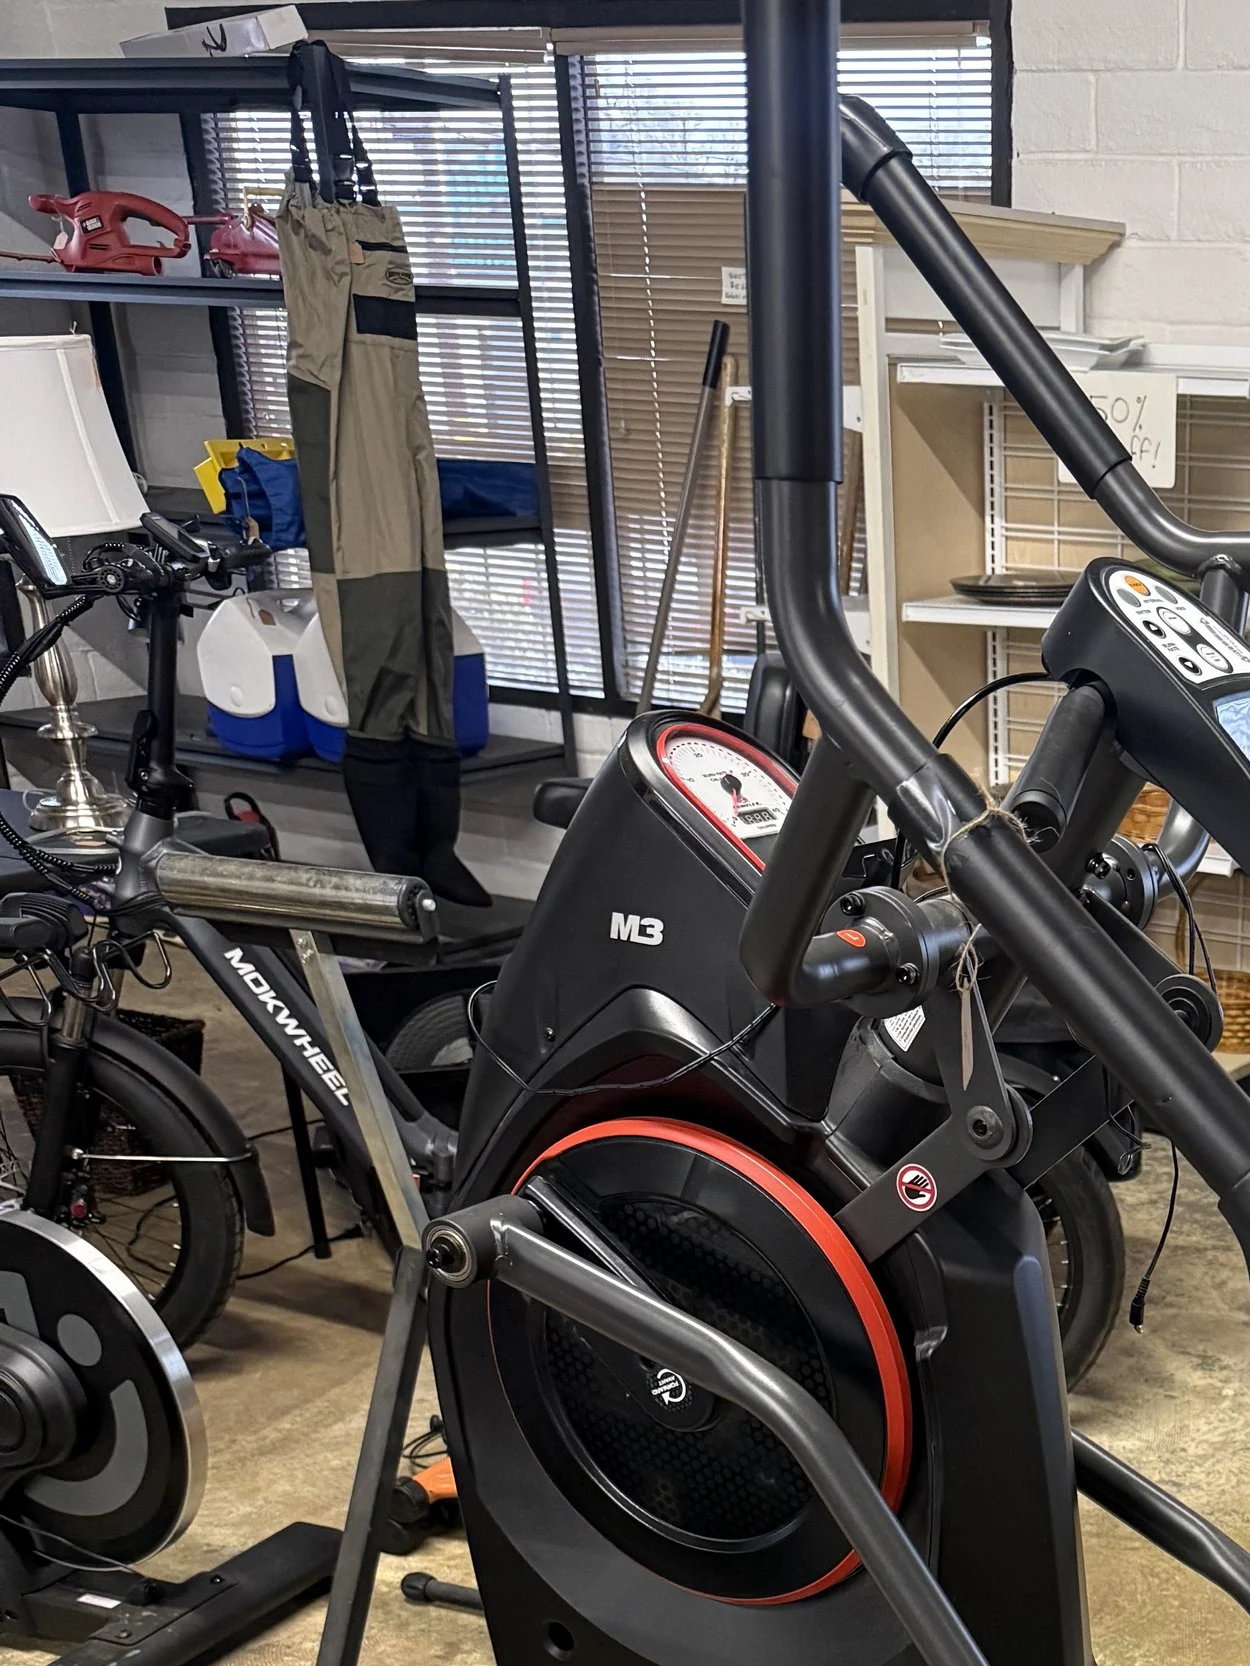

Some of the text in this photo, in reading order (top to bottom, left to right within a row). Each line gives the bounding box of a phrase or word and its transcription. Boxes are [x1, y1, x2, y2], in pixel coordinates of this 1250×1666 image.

[1129, 434, 1161, 469] ff!
[609, 911, 664, 946] M3
[224, 947, 350, 1106] MOKWHEEL
